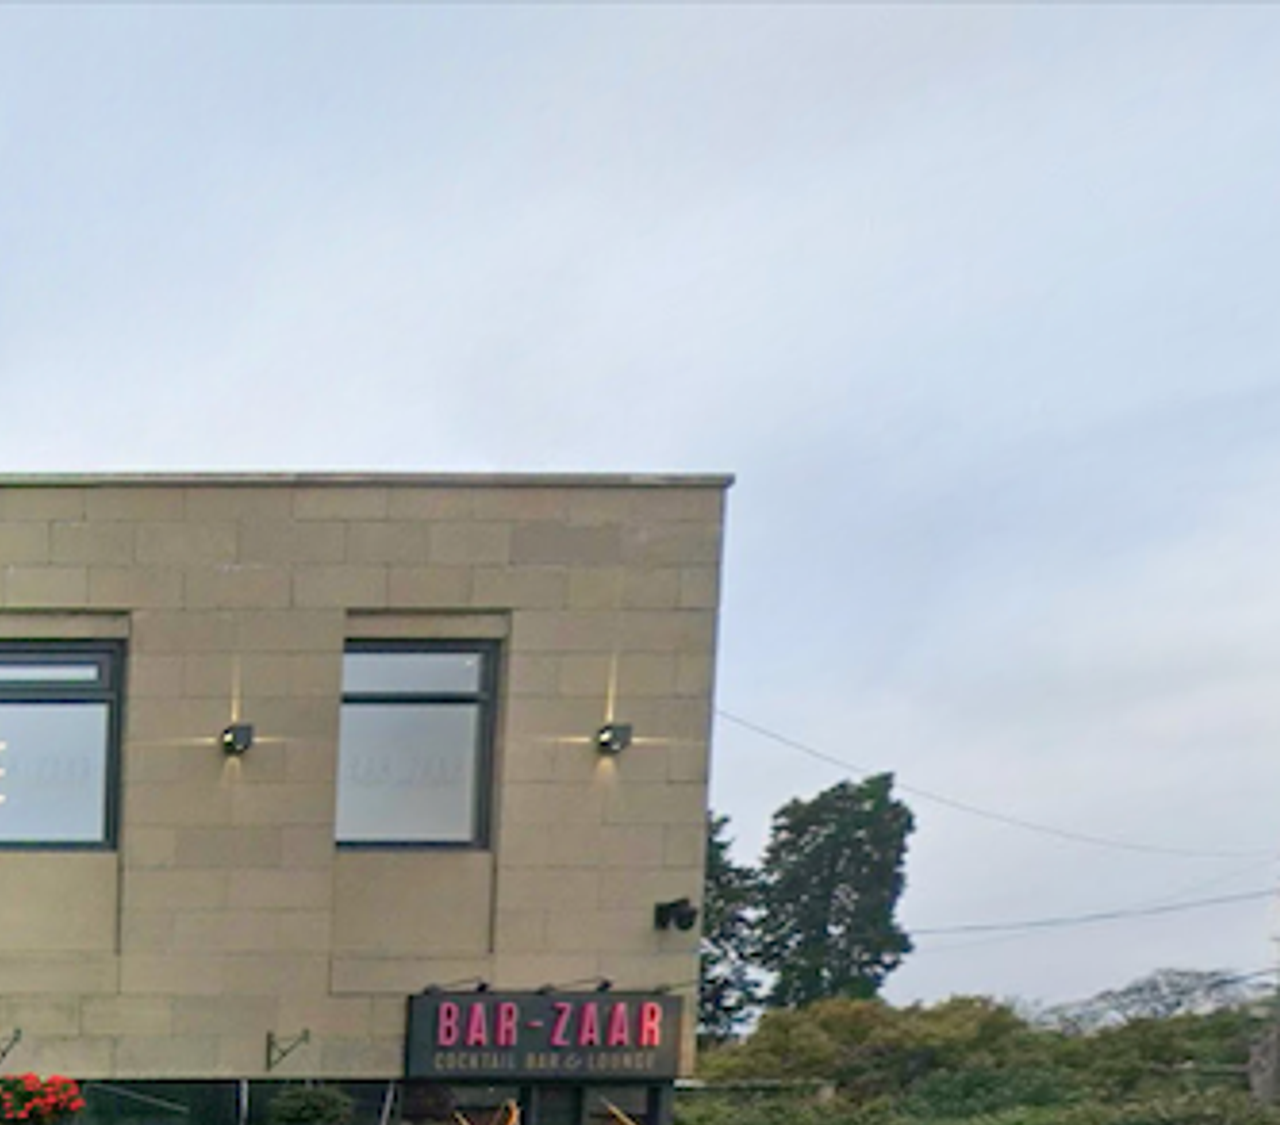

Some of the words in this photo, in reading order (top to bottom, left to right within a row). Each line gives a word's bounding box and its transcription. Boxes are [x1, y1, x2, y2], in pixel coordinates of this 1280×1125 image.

[437, 1001, 663, 1047] BAR-ZAAR
[434, 1051, 515, 1070] COCKTAIL
[526, 1051, 559, 1070] BAR
[563, 1053, 583, 1070] &
[588, 1051, 656, 1070] LOUNGE
